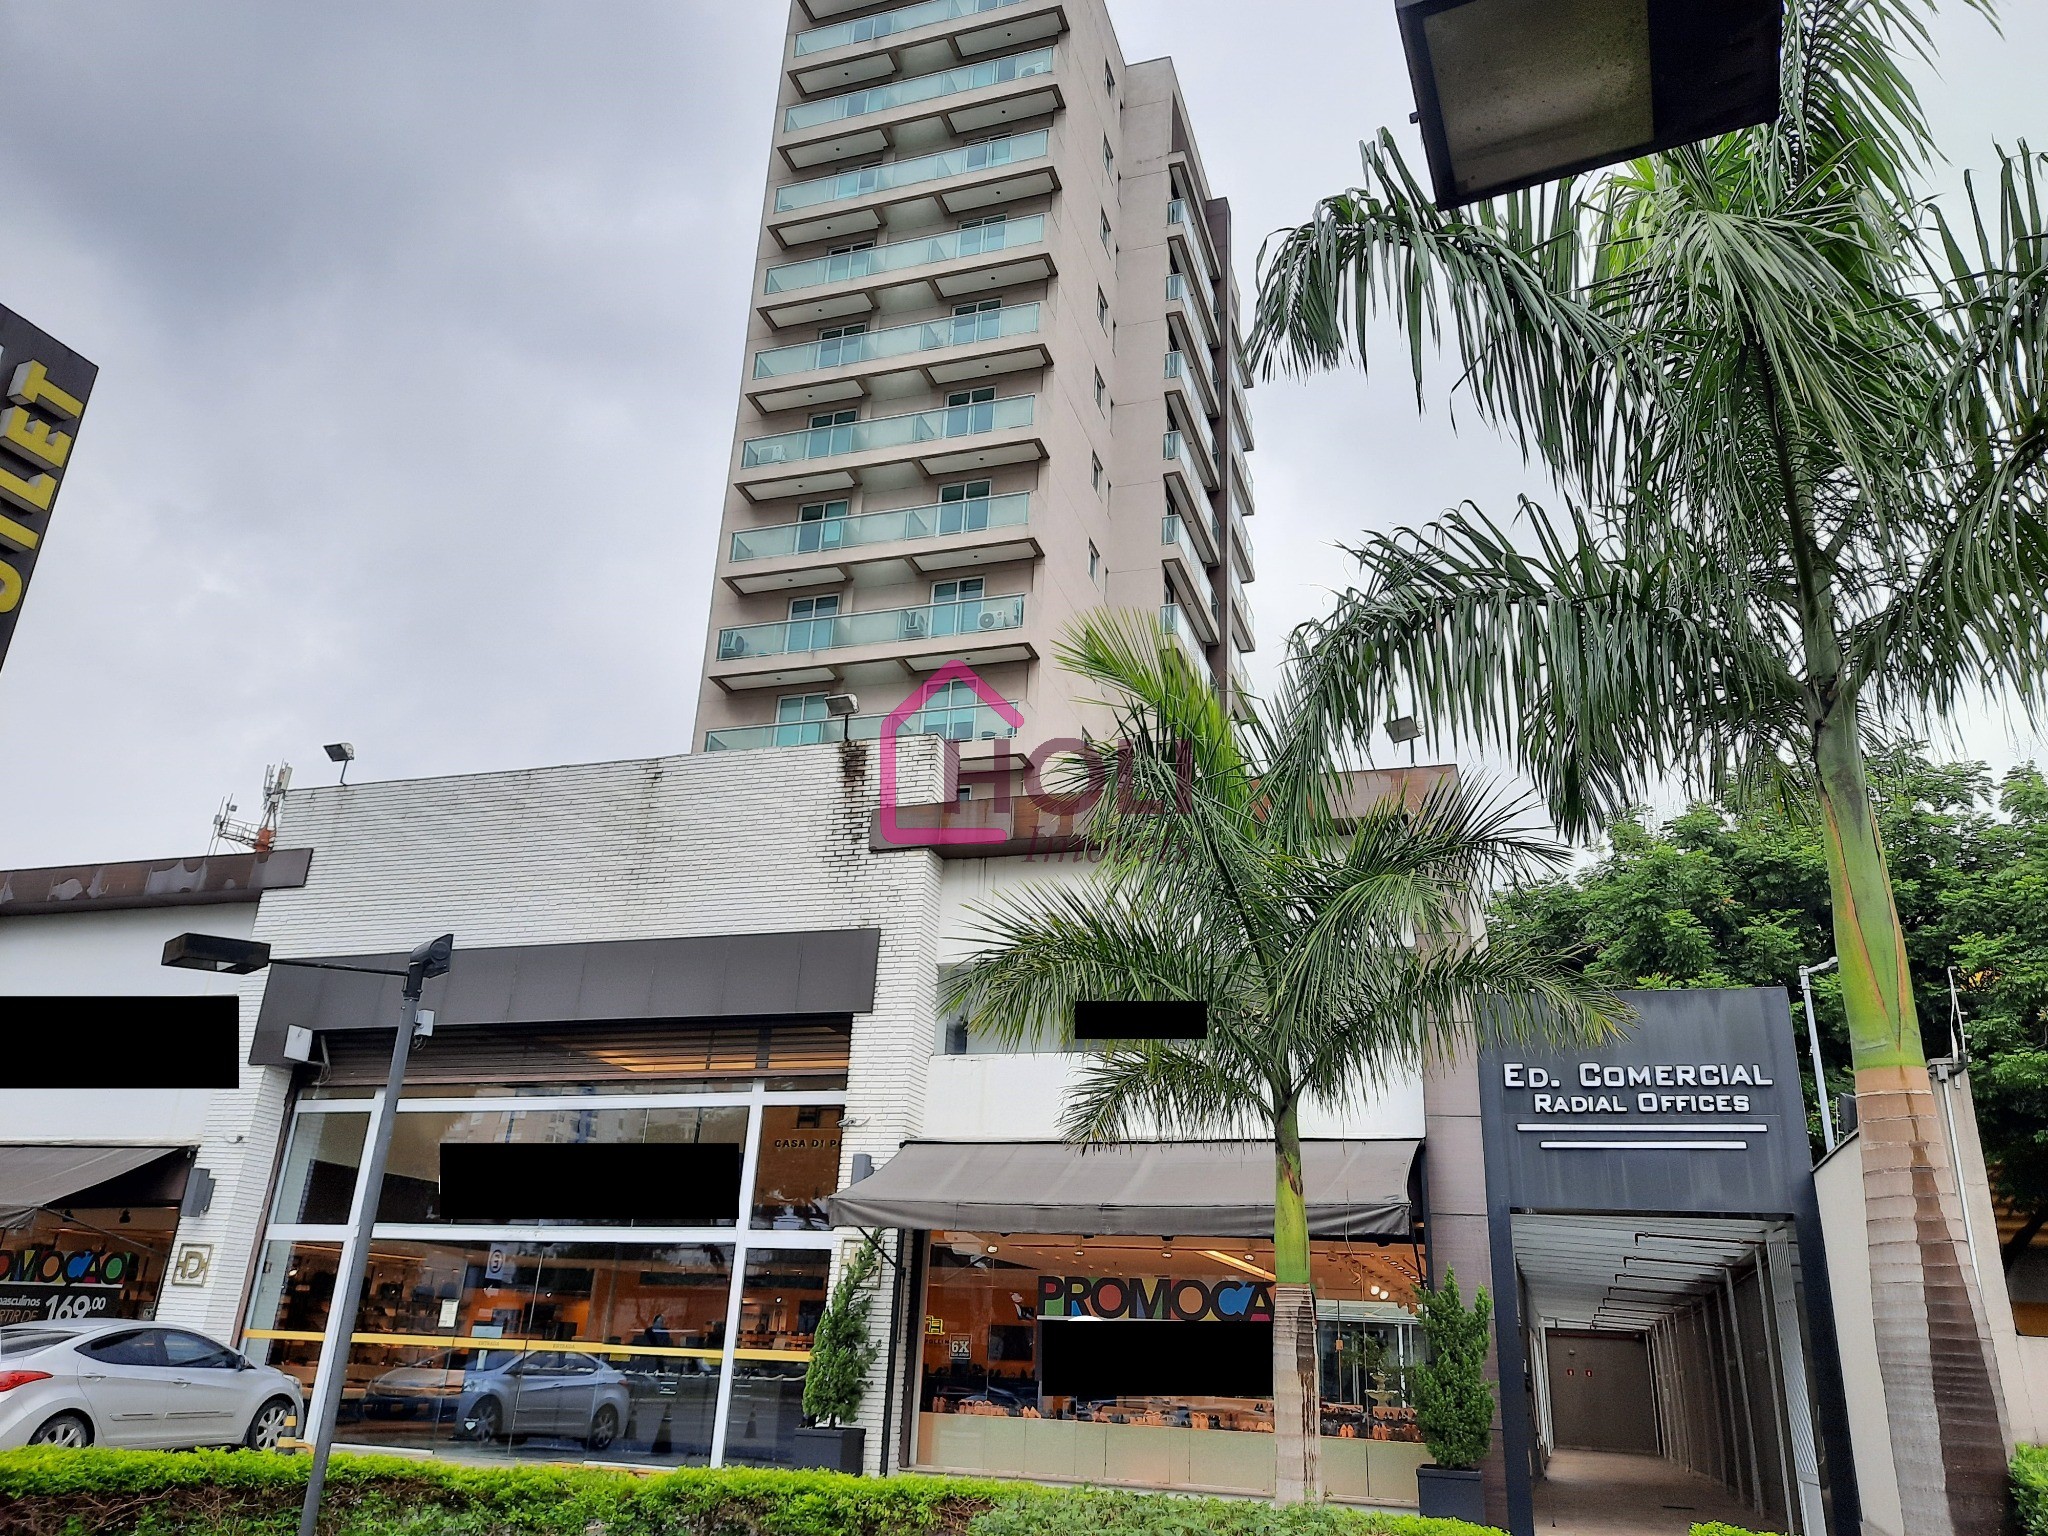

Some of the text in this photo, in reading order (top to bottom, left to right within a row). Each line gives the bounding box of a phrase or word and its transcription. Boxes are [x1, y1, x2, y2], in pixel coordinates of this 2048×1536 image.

[1578, 1061, 1775, 1089] COMERCIAL
[1533, 1091, 1751, 1114] RADIAL OFFICES
[774, 1139, 806, 1149] CASA
[811, 1139, 825, 1149] DI
[951, 1340, 970, 1353] 6X
